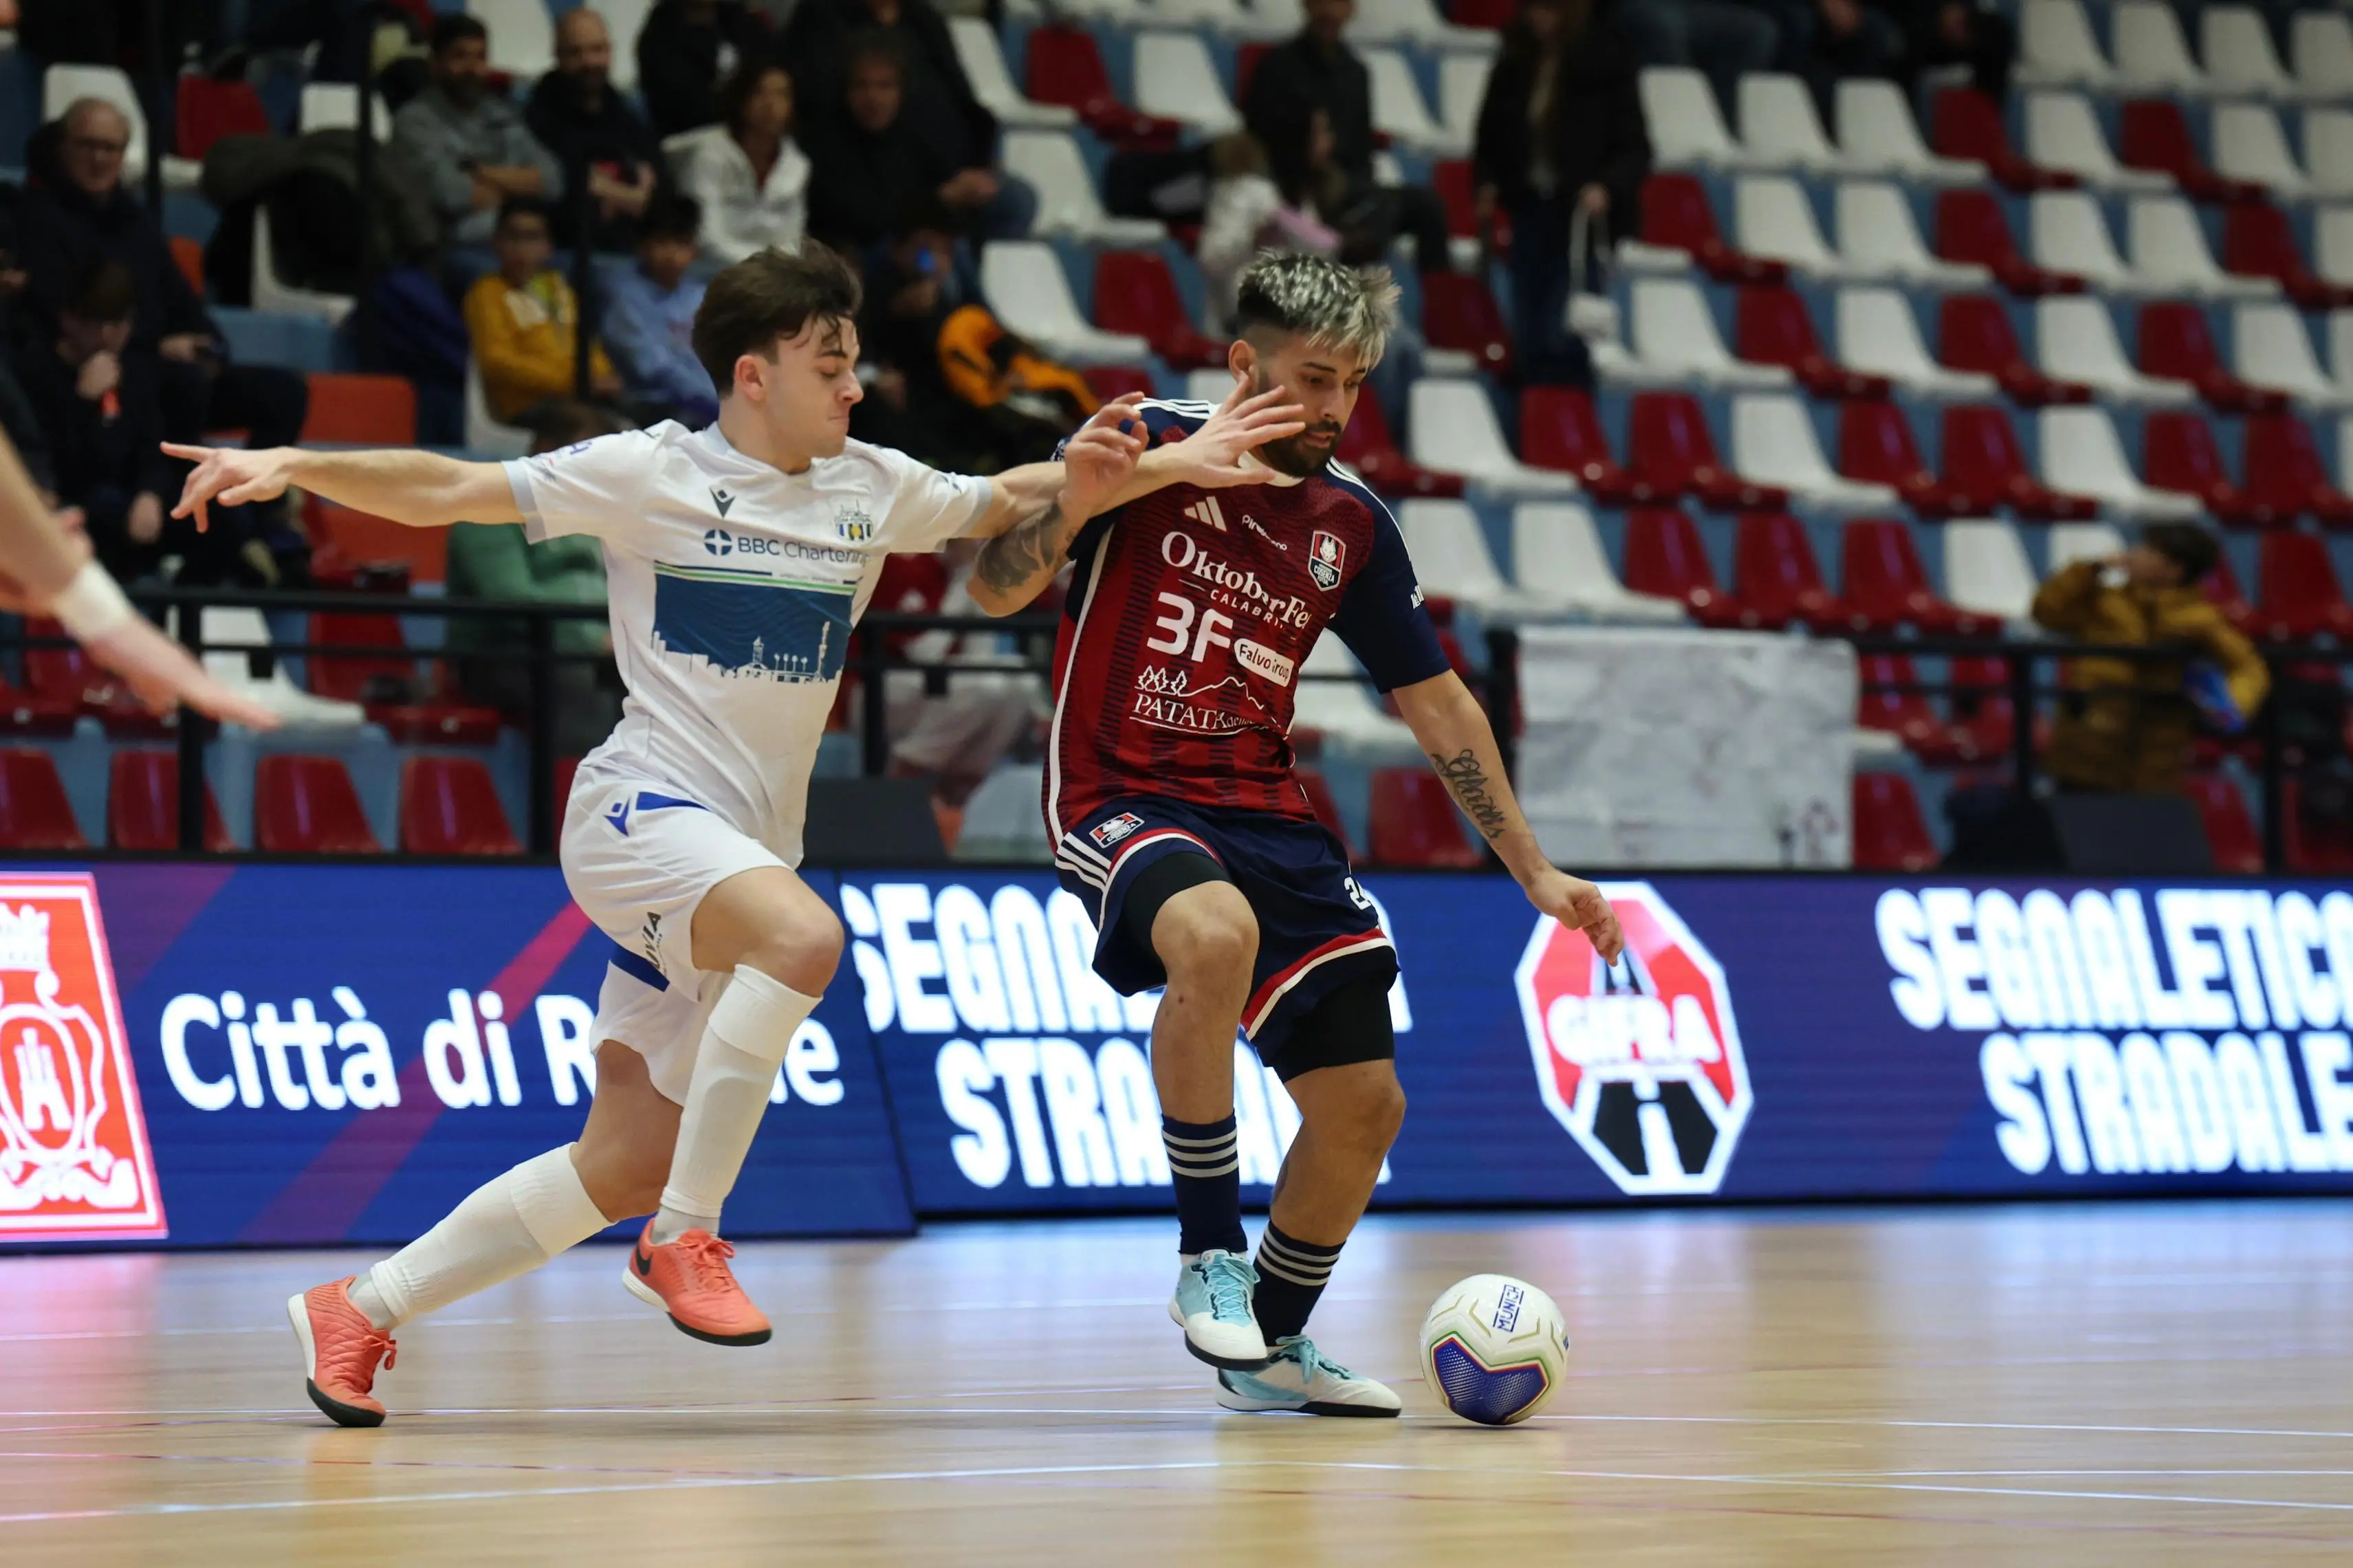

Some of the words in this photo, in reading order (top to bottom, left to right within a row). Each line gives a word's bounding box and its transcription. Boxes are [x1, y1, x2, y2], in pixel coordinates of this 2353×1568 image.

[738, 536, 780, 555] BBC
[1146, 591, 1234, 663] 3F
[1239, 643, 1271, 670] Falvo
[160, 986, 401, 1111] Città
[422, 988, 522, 1109] di
[1497, 1284, 1520, 1332] MUNICH
